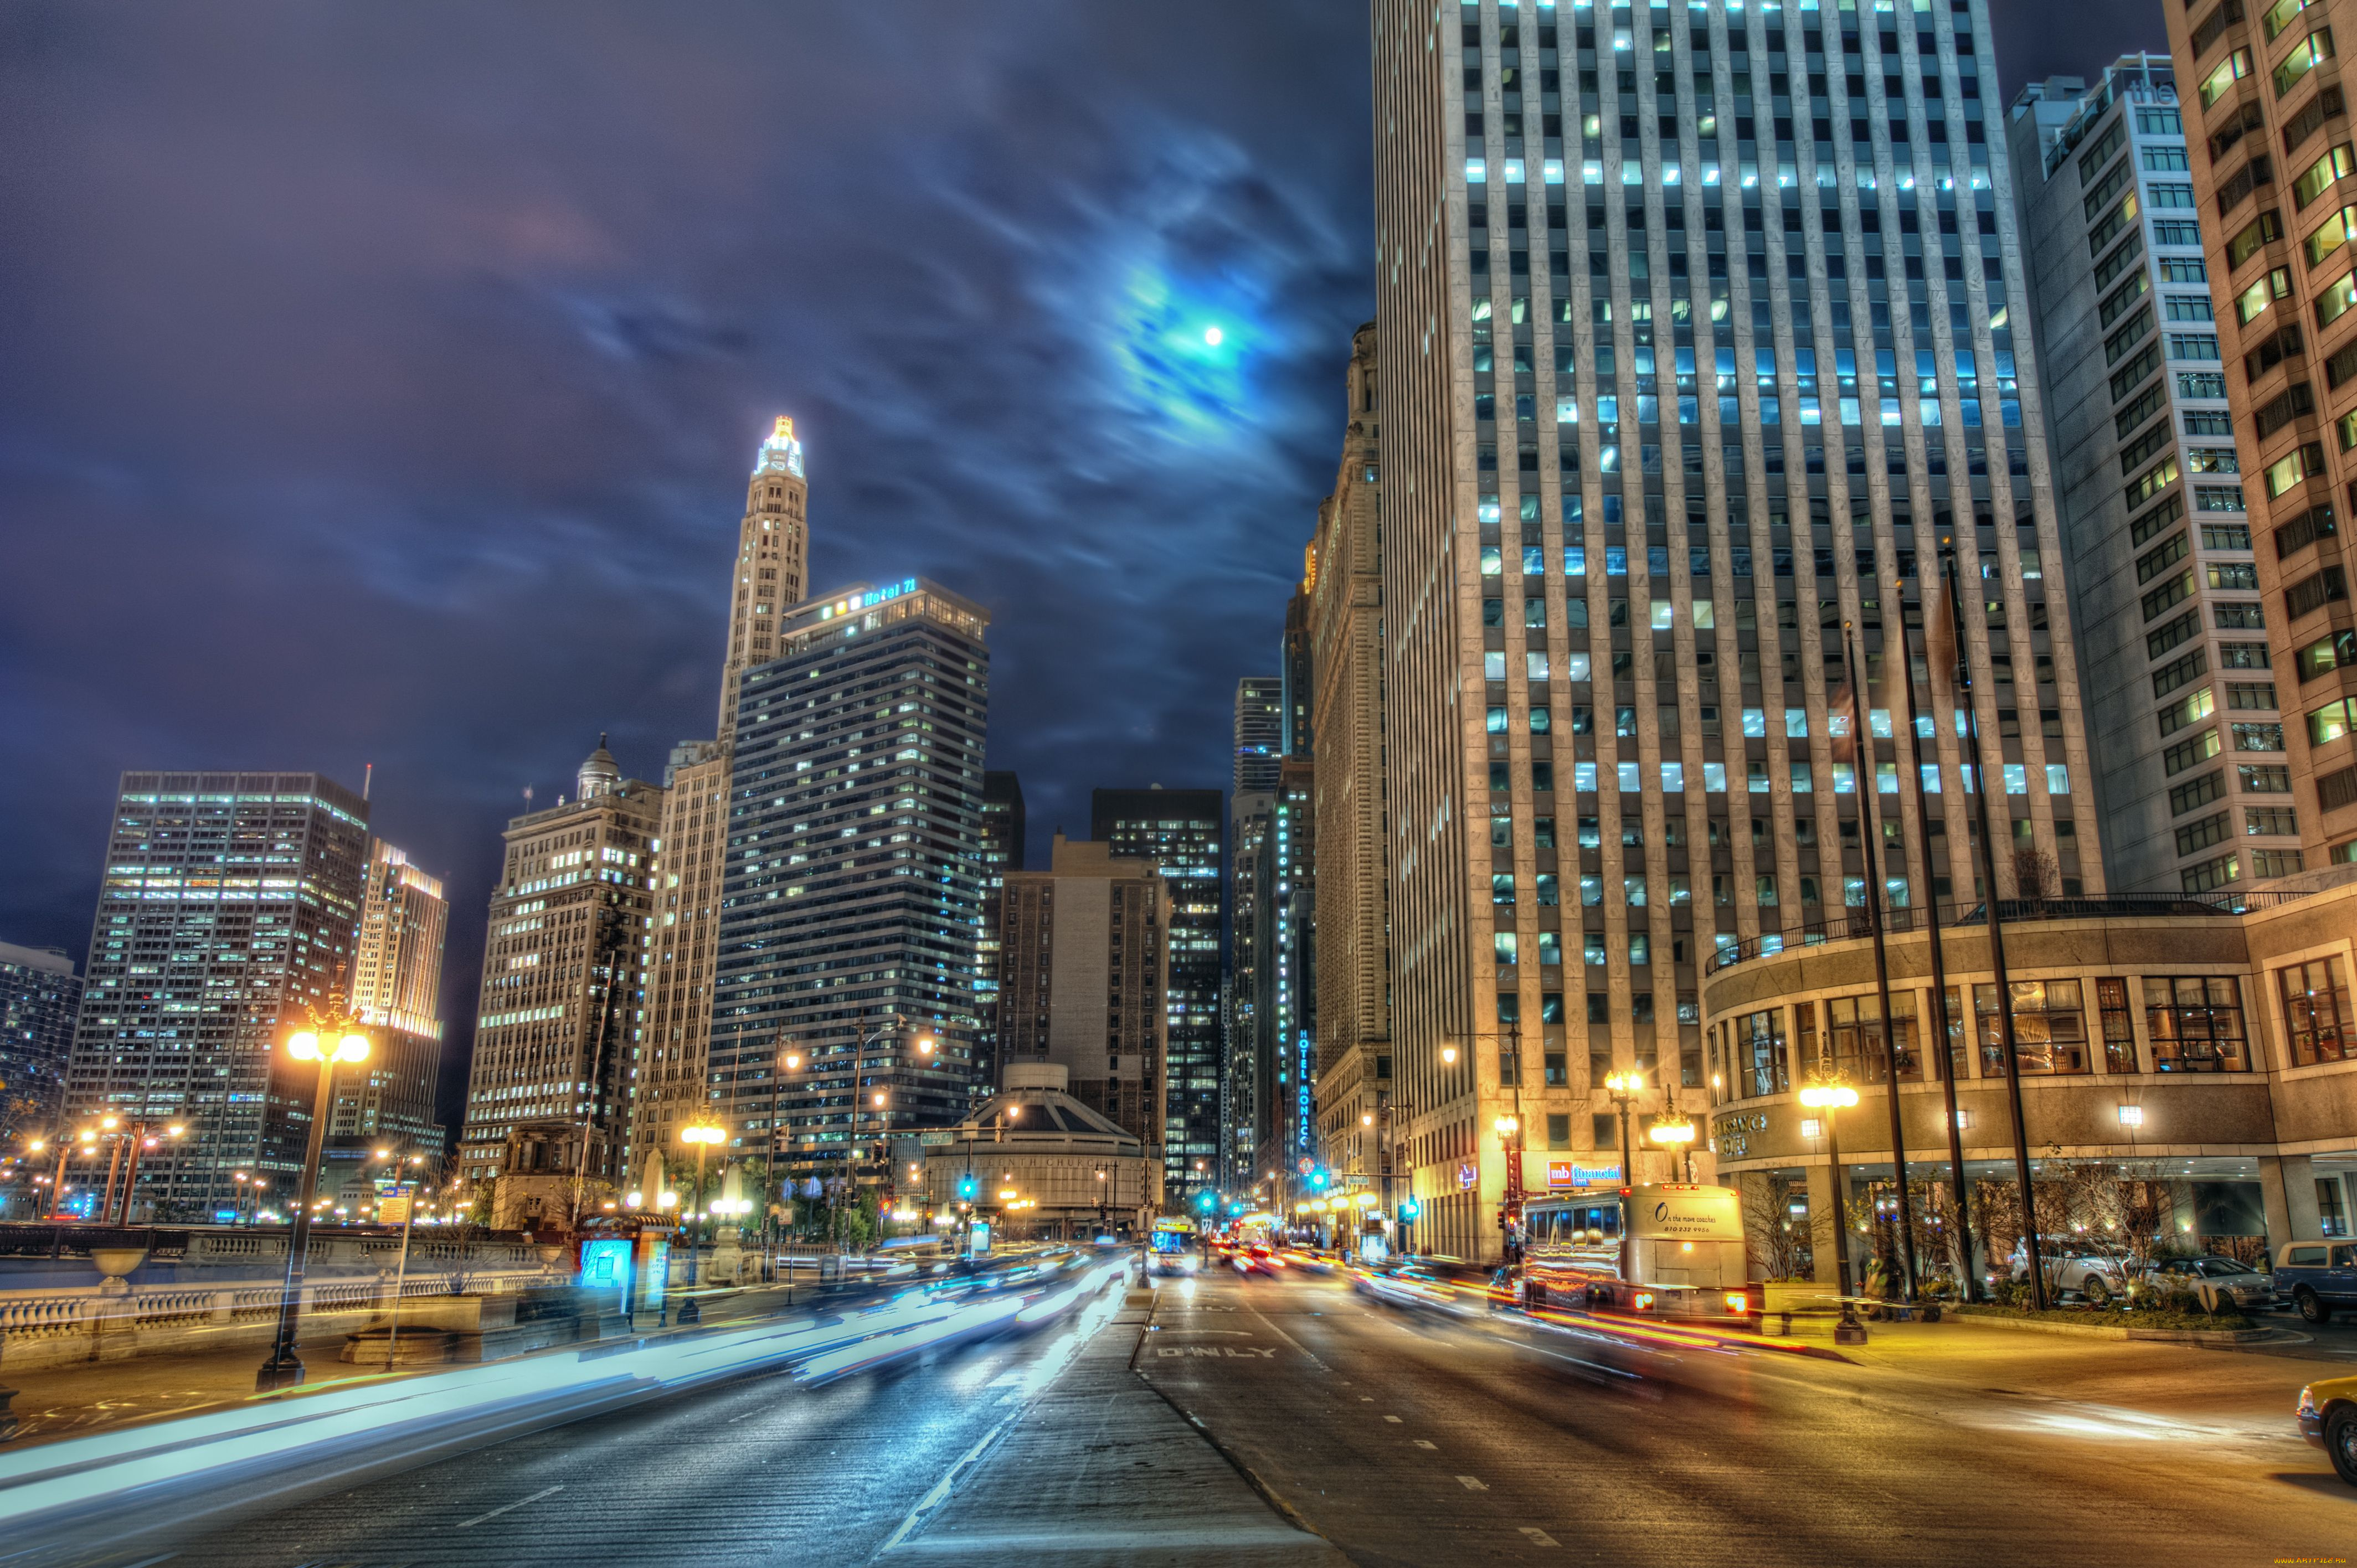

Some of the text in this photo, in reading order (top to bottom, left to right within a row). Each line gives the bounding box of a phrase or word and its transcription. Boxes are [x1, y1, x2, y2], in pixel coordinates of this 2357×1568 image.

[864, 579, 915, 606] Hotel 71
[1278, 806, 1288, 891] MORTONS
[1299, 1030, 1309, 1079] HOTEL
[936, 1158, 1036, 1168] SEVENTEENTH
[1551, 1165, 1622, 1179] mb financial
[1157, 1347, 1276, 1358] ONLY
